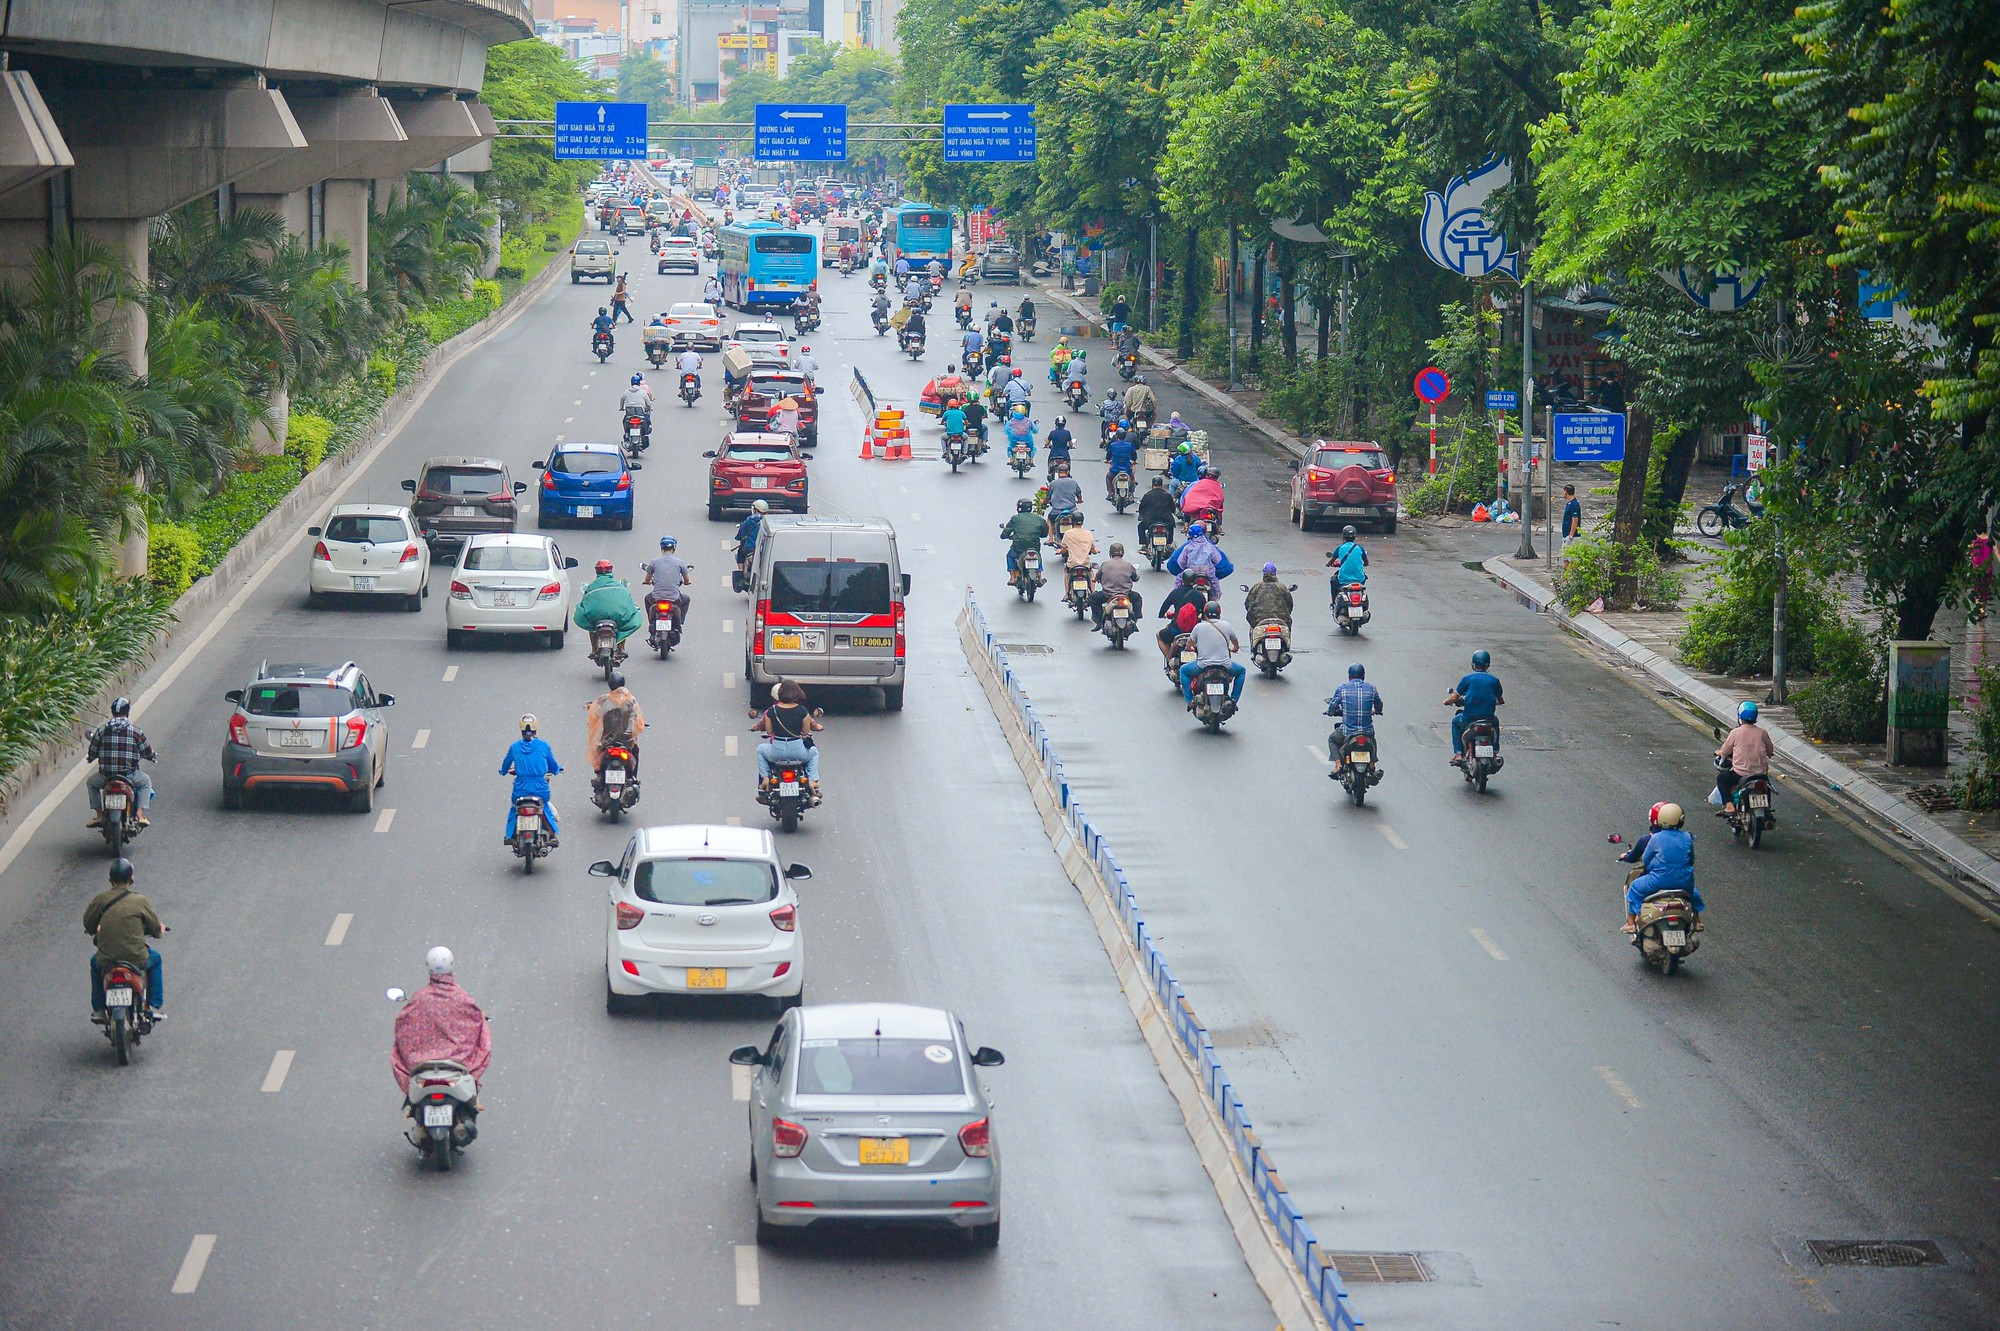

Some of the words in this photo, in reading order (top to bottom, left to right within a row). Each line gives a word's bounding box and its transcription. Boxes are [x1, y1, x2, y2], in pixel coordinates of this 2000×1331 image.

[558, 122, 568, 131] NÚT
[759, 124, 778, 132] ĐƯỜNG
[947, 125, 966, 133] ĐƯỜNG
[968, 125, 990, 133] TRƯỜNG
[558, 134, 568, 142] NÚT
[759, 136, 770, 144] NÚT
[948, 137, 958, 145] NÚT
[1594, 425, 1607, 435] QUÂN
[1567, 435, 1583, 444] PHƯỜNG
[1584, 436, 1600, 445] THƯỢNG
[1601, 436, 1611, 444] ĐÌNH
[1752, 450, 1762, 459] XÔI
